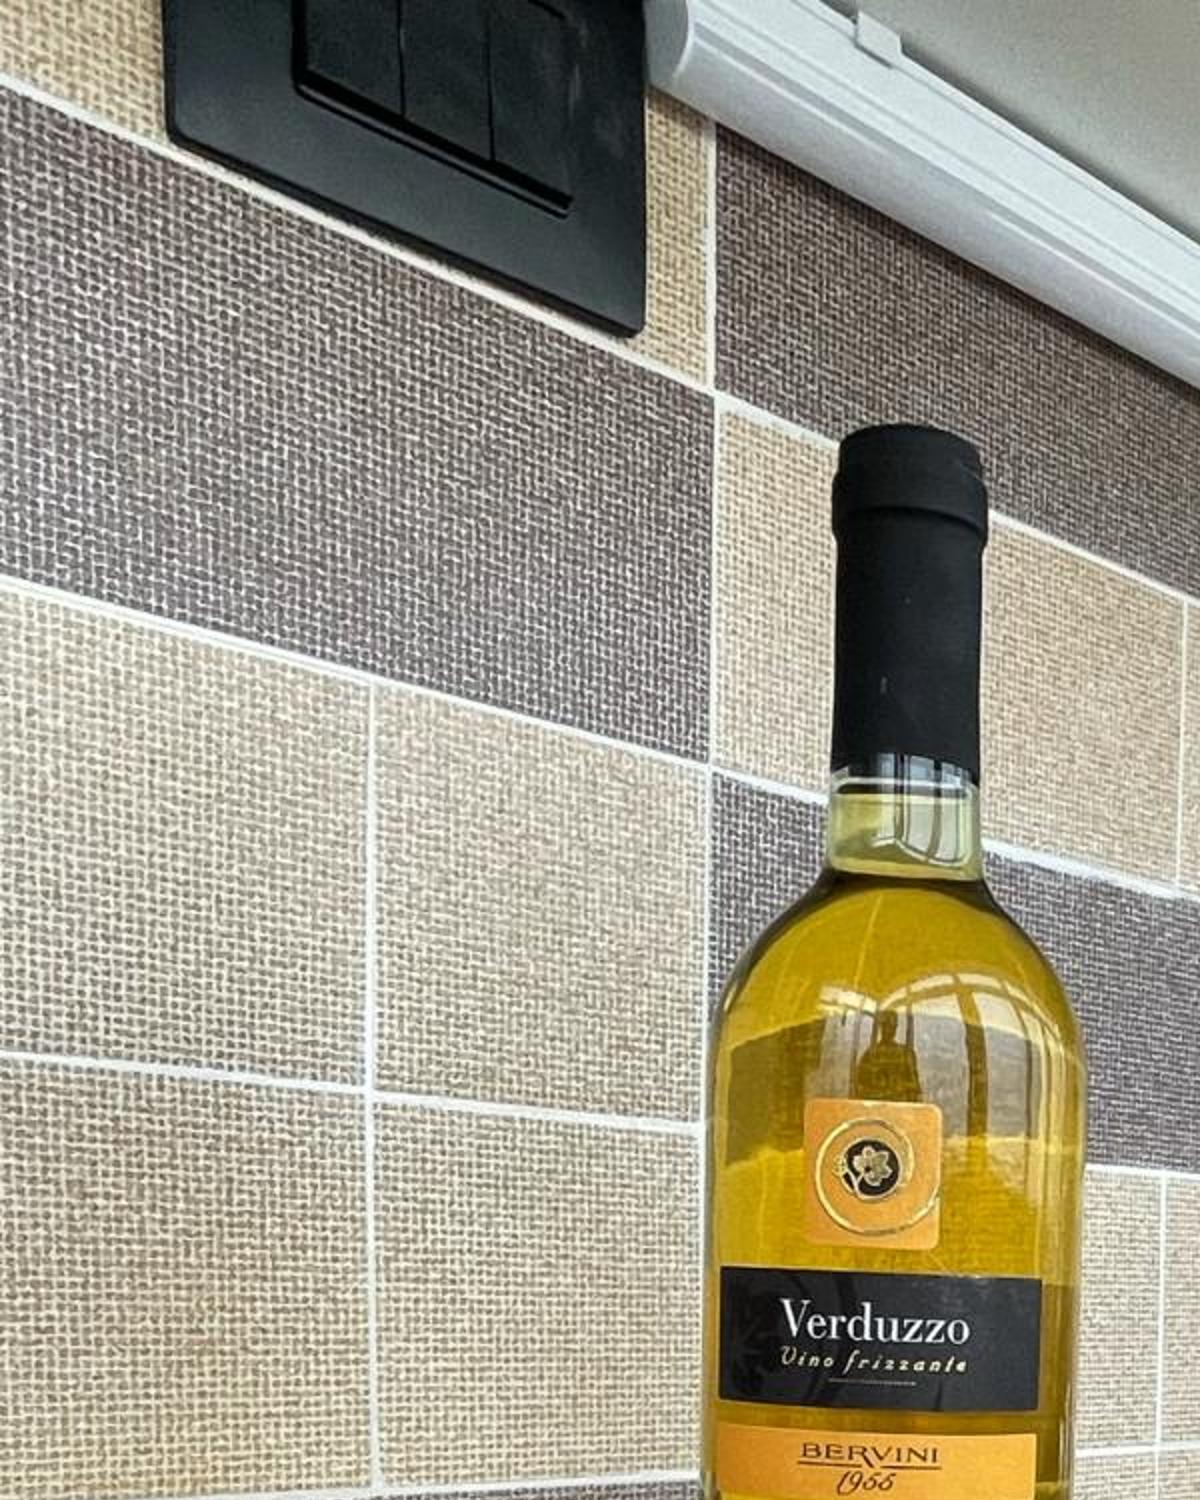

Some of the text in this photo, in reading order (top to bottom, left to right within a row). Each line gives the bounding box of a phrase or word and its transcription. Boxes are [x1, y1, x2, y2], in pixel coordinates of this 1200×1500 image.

[779, 1298, 971, 1345] Verduzzo
[780, 1345, 968, 1376] Vino frizzante
[801, 1442, 938, 1469] BERVINI
